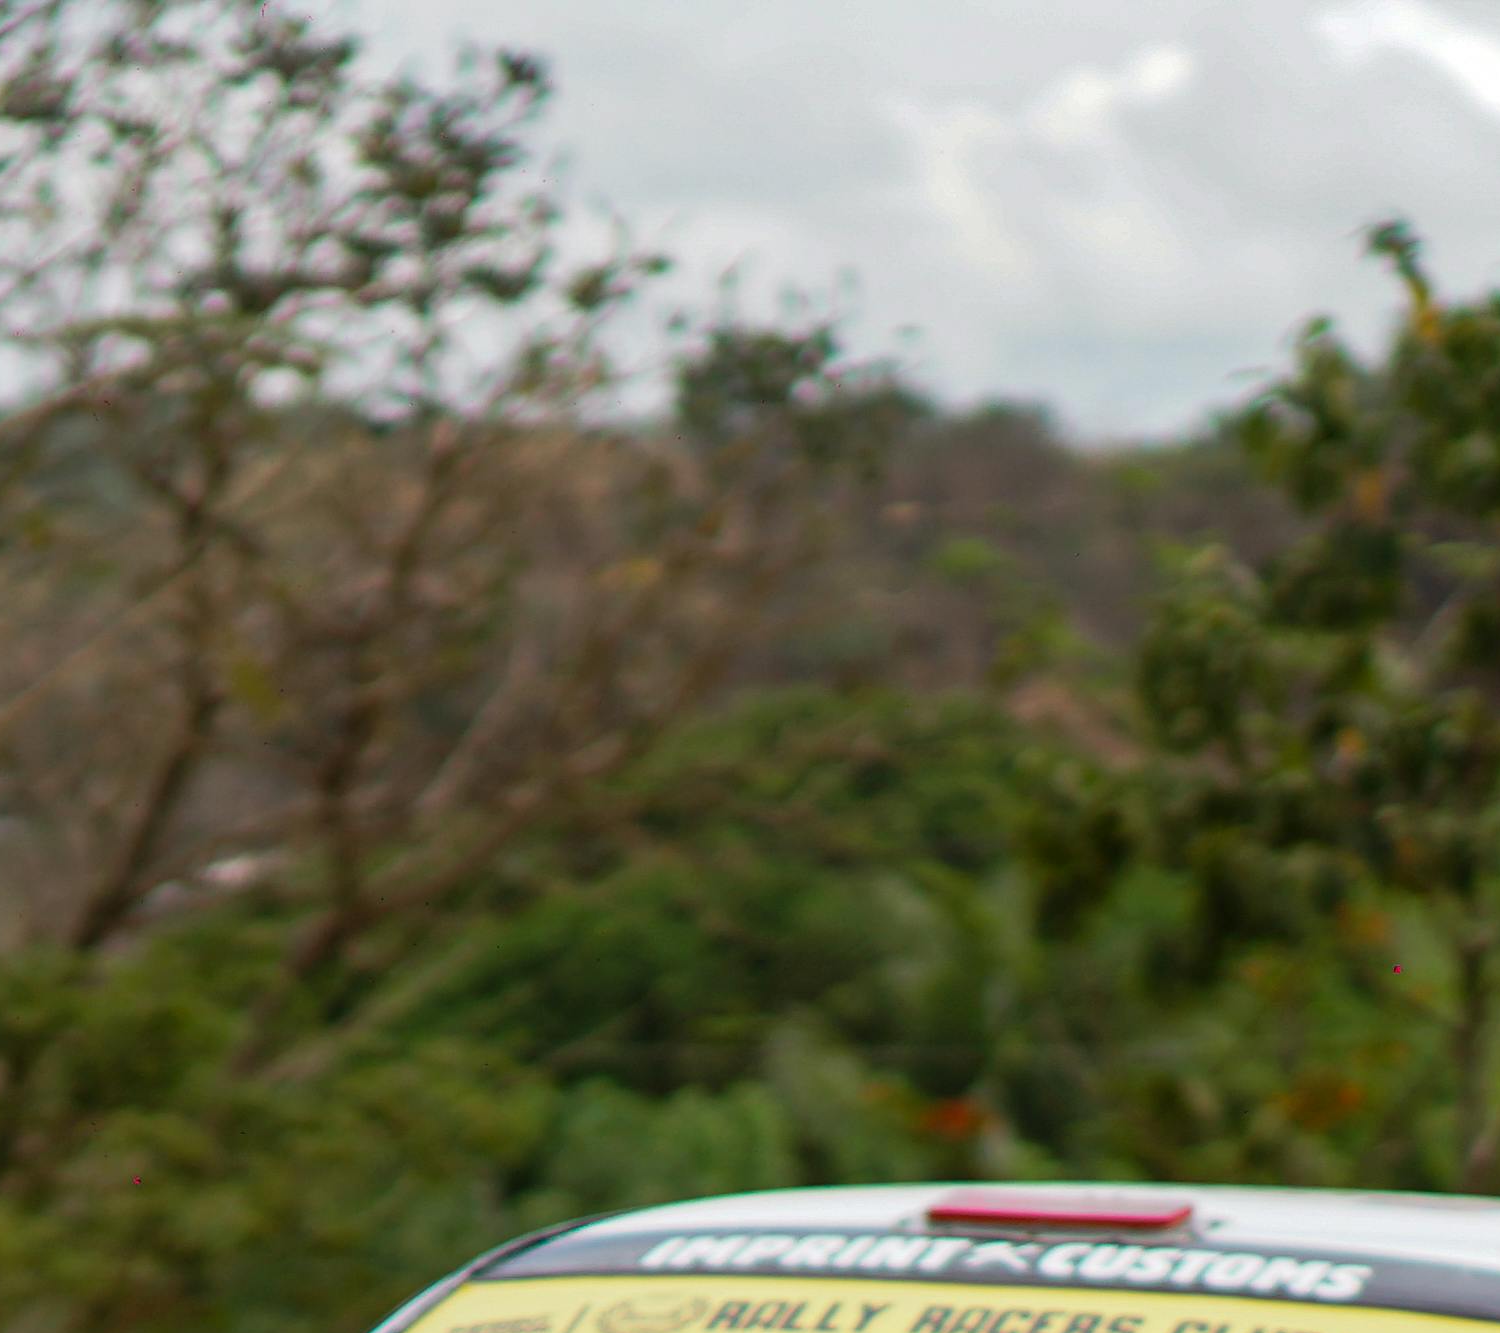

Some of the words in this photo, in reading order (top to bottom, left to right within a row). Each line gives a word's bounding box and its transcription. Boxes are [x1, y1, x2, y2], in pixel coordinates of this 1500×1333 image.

[639, 1234, 972, 1270] IMPRINT
[1038, 1242, 1373, 1299] CUSTOMS
[706, 1298, 893, 1333] RALLY
